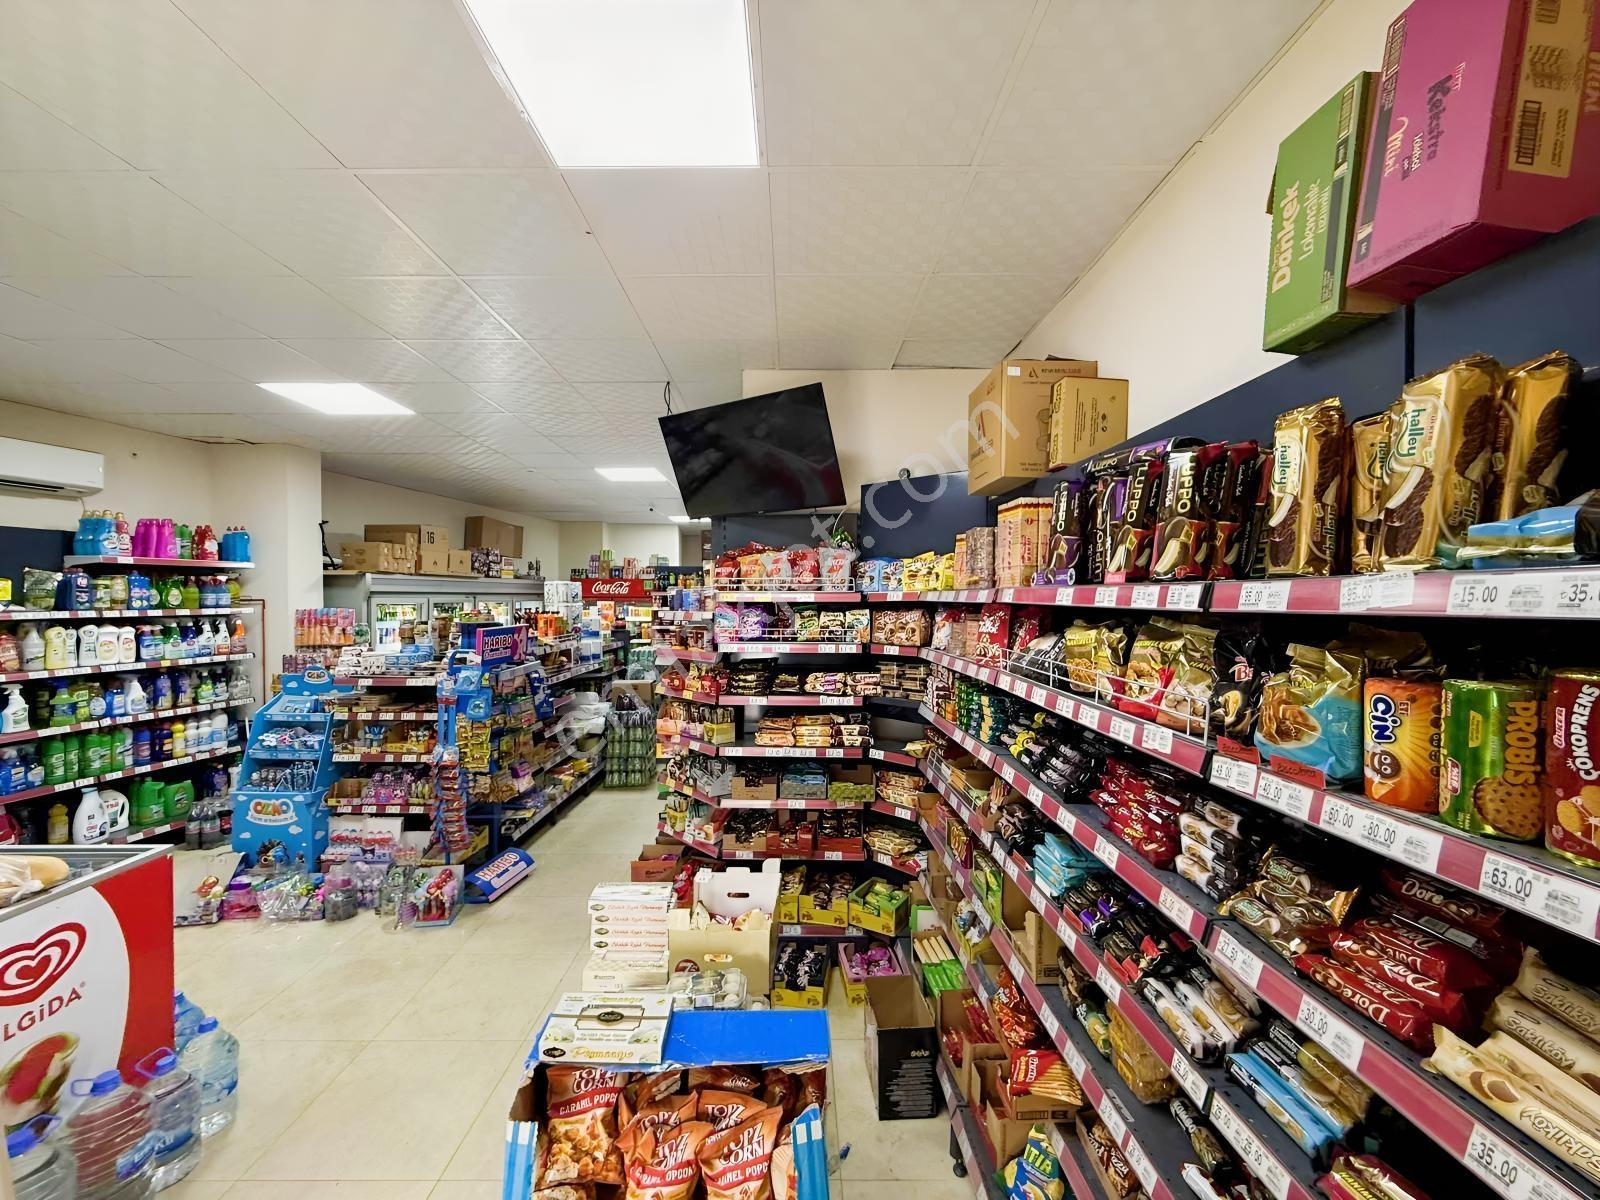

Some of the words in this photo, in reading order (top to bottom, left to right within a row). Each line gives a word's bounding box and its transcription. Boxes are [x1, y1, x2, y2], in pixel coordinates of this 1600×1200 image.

[1271, 180, 1300, 294] Dankek
[1407, 408, 1426, 458] halley
[1279, 444, 1291, 486] halley
[1126, 466, 1148, 522] LUPPO
[426, 530, 435, 545] 16
[1460, 586, 1498, 602] 15.00
[1568, 584, 1600, 602] 35.
[483, 634, 513, 650] HARIBO
[1367, 821, 1396, 845] 80.00
[475, 852, 521, 882] HARIBO
[1401, 877, 1444, 905] Dore
[1491, 867, 1533, 898] 63.00
[1304, 1008, 1328, 1034] 30.00
[1342, 988, 1390, 1027] Dore
[719, 1139, 765, 1167] CORN
[1477, 1141, 1519, 1185] 35.00
